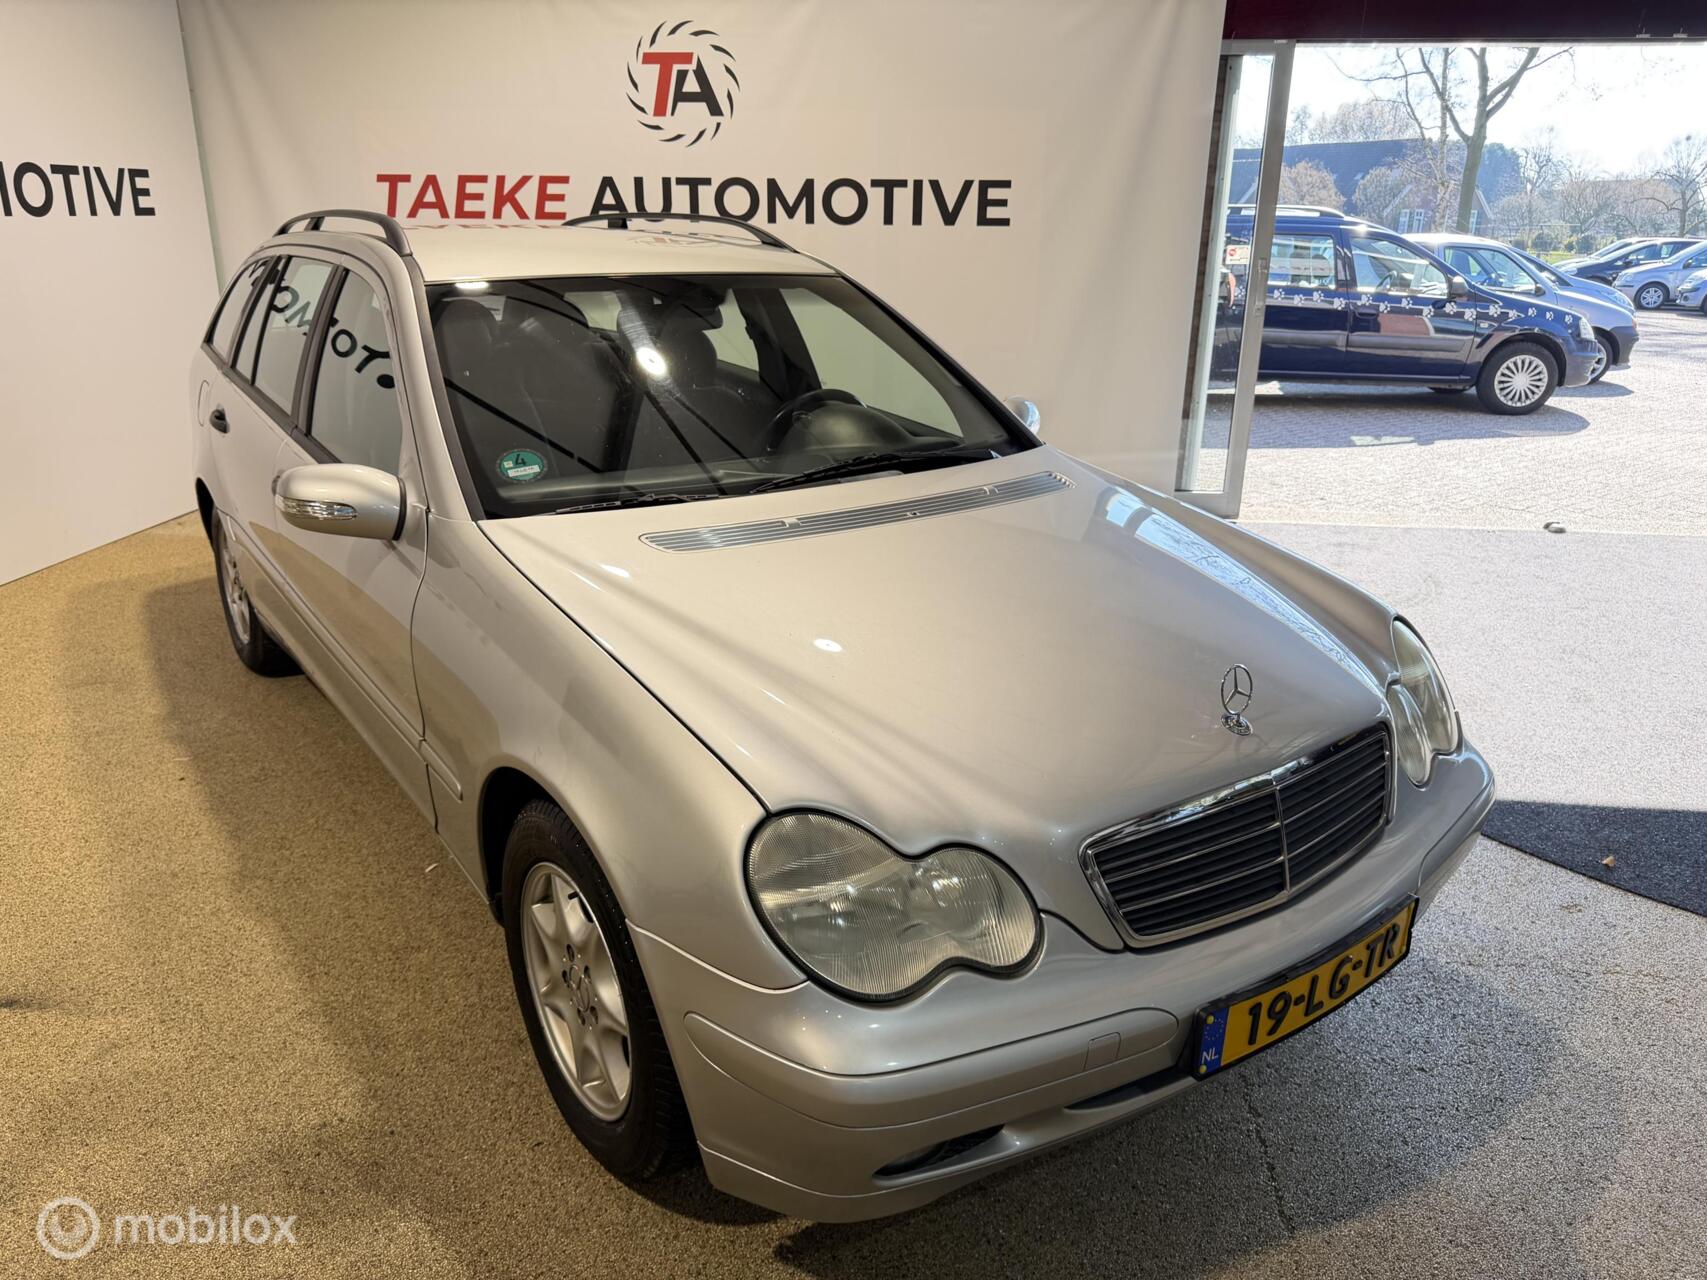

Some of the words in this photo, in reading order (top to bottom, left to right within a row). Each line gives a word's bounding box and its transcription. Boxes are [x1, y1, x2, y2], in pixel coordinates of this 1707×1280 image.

[641, 51, 724, 117] TA
[376, 174, 570, 220] TAEKE
[590, 176, 1012, 226] AUTOMOTIVE
[515, 453, 526, 466] 4
[1248, 923, 1400, 1046] 19-LG-TR
[1201, 1047, 1219, 1064] NL
